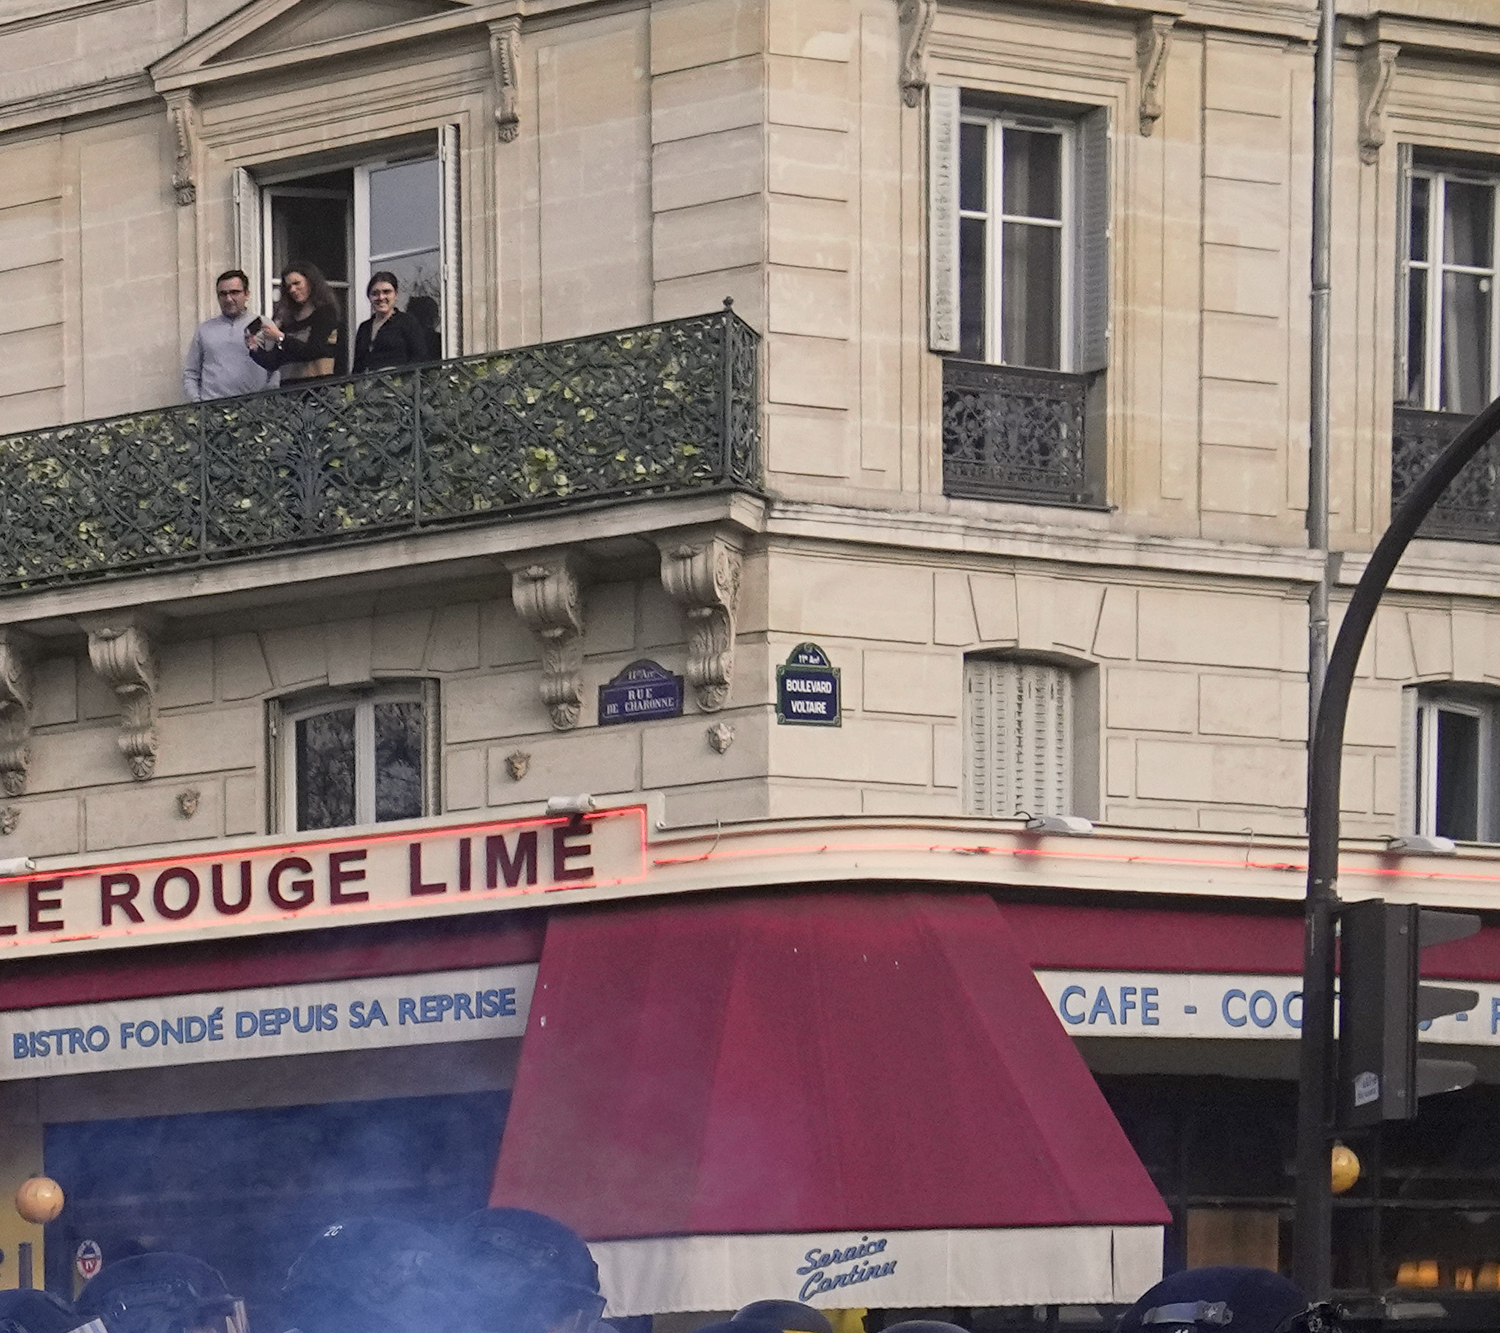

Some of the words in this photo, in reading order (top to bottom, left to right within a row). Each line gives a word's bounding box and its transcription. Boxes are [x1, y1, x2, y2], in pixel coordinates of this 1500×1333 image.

[627, 688, 653, 701] RUE
[786, 679, 832, 694] BOULEVARD
[606, 703, 619, 714] DE
[624, 697, 675, 713] CHARONNE
[790, 700, 827, 714] VOLTAIRE
[100, 849, 370, 927] ROUGE
[1059, 985, 1160, 1025] CAFE
[13, 1025, 110, 1060] BISTRO
[120, 1007, 224, 1050] FONDÉ
[236, 1004, 338, 1039] DEPUIS
[348, 998, 389, 1028] SA
[398, 987, 517, 1025] REPRISE
[796, 1235, 888, 1275] Service
